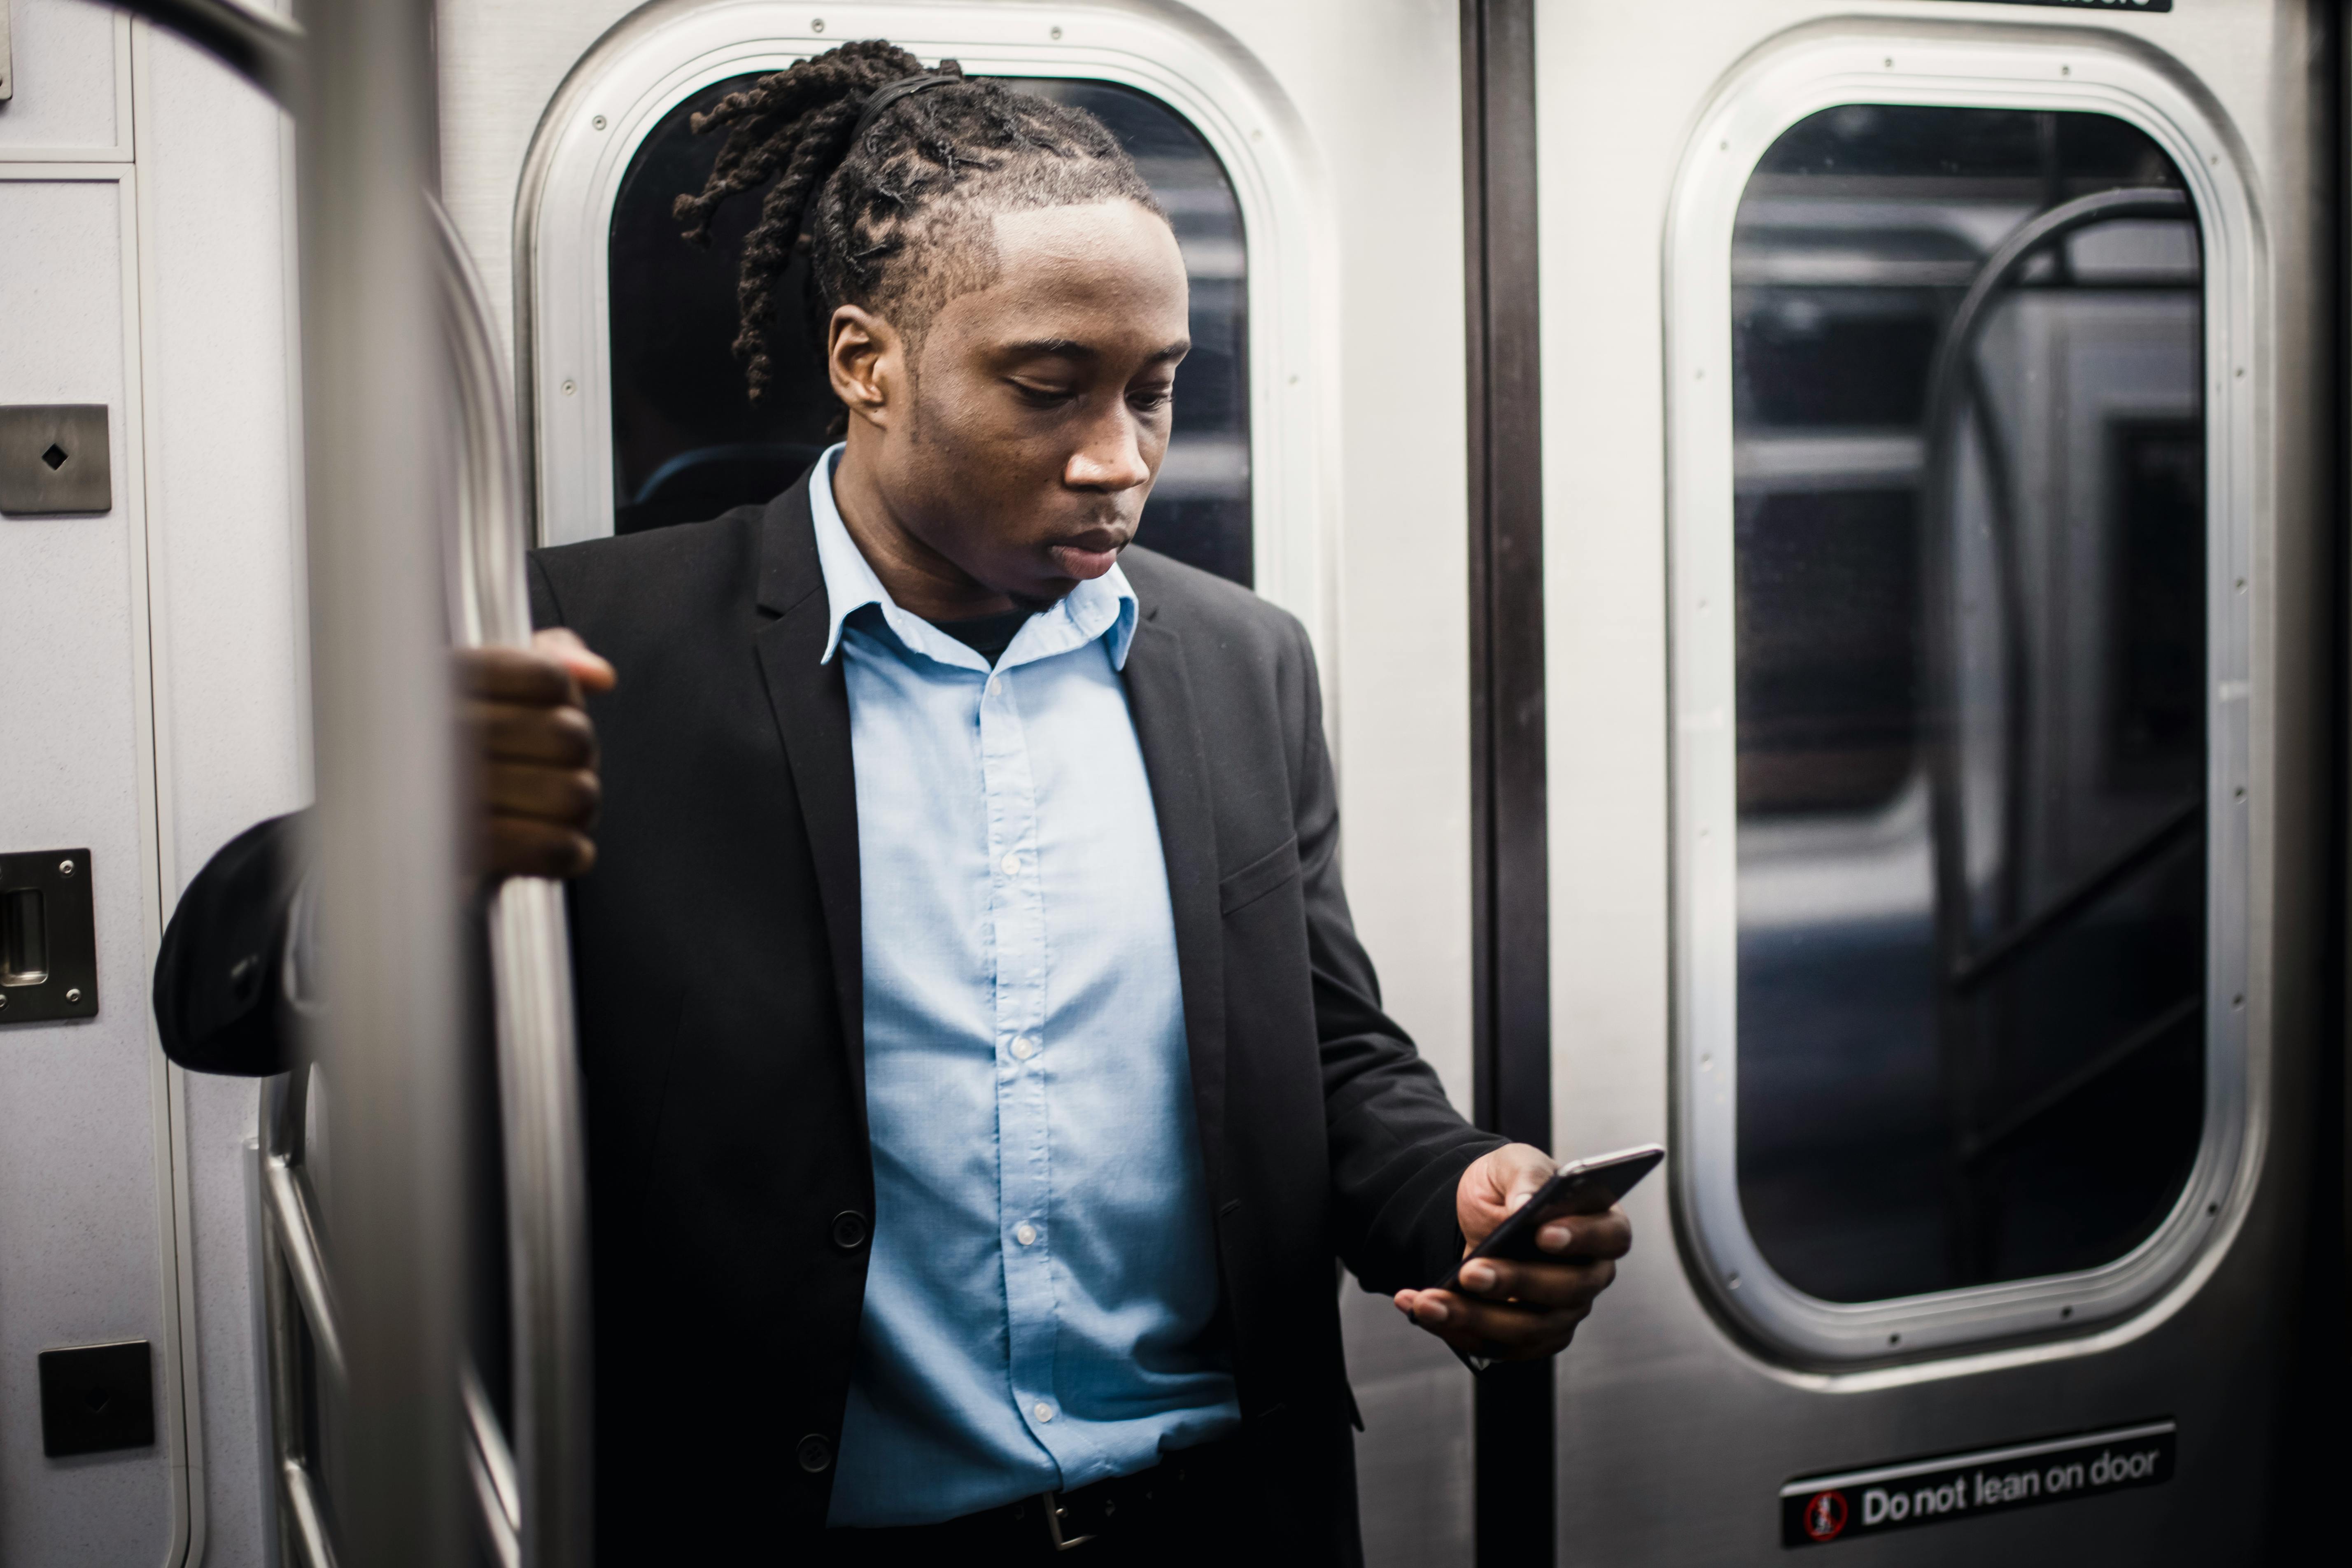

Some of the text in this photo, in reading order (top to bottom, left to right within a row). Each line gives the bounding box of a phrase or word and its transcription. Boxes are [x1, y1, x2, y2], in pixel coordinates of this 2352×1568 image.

[1863, 1450, 2159, 1525] Do not lean on door
